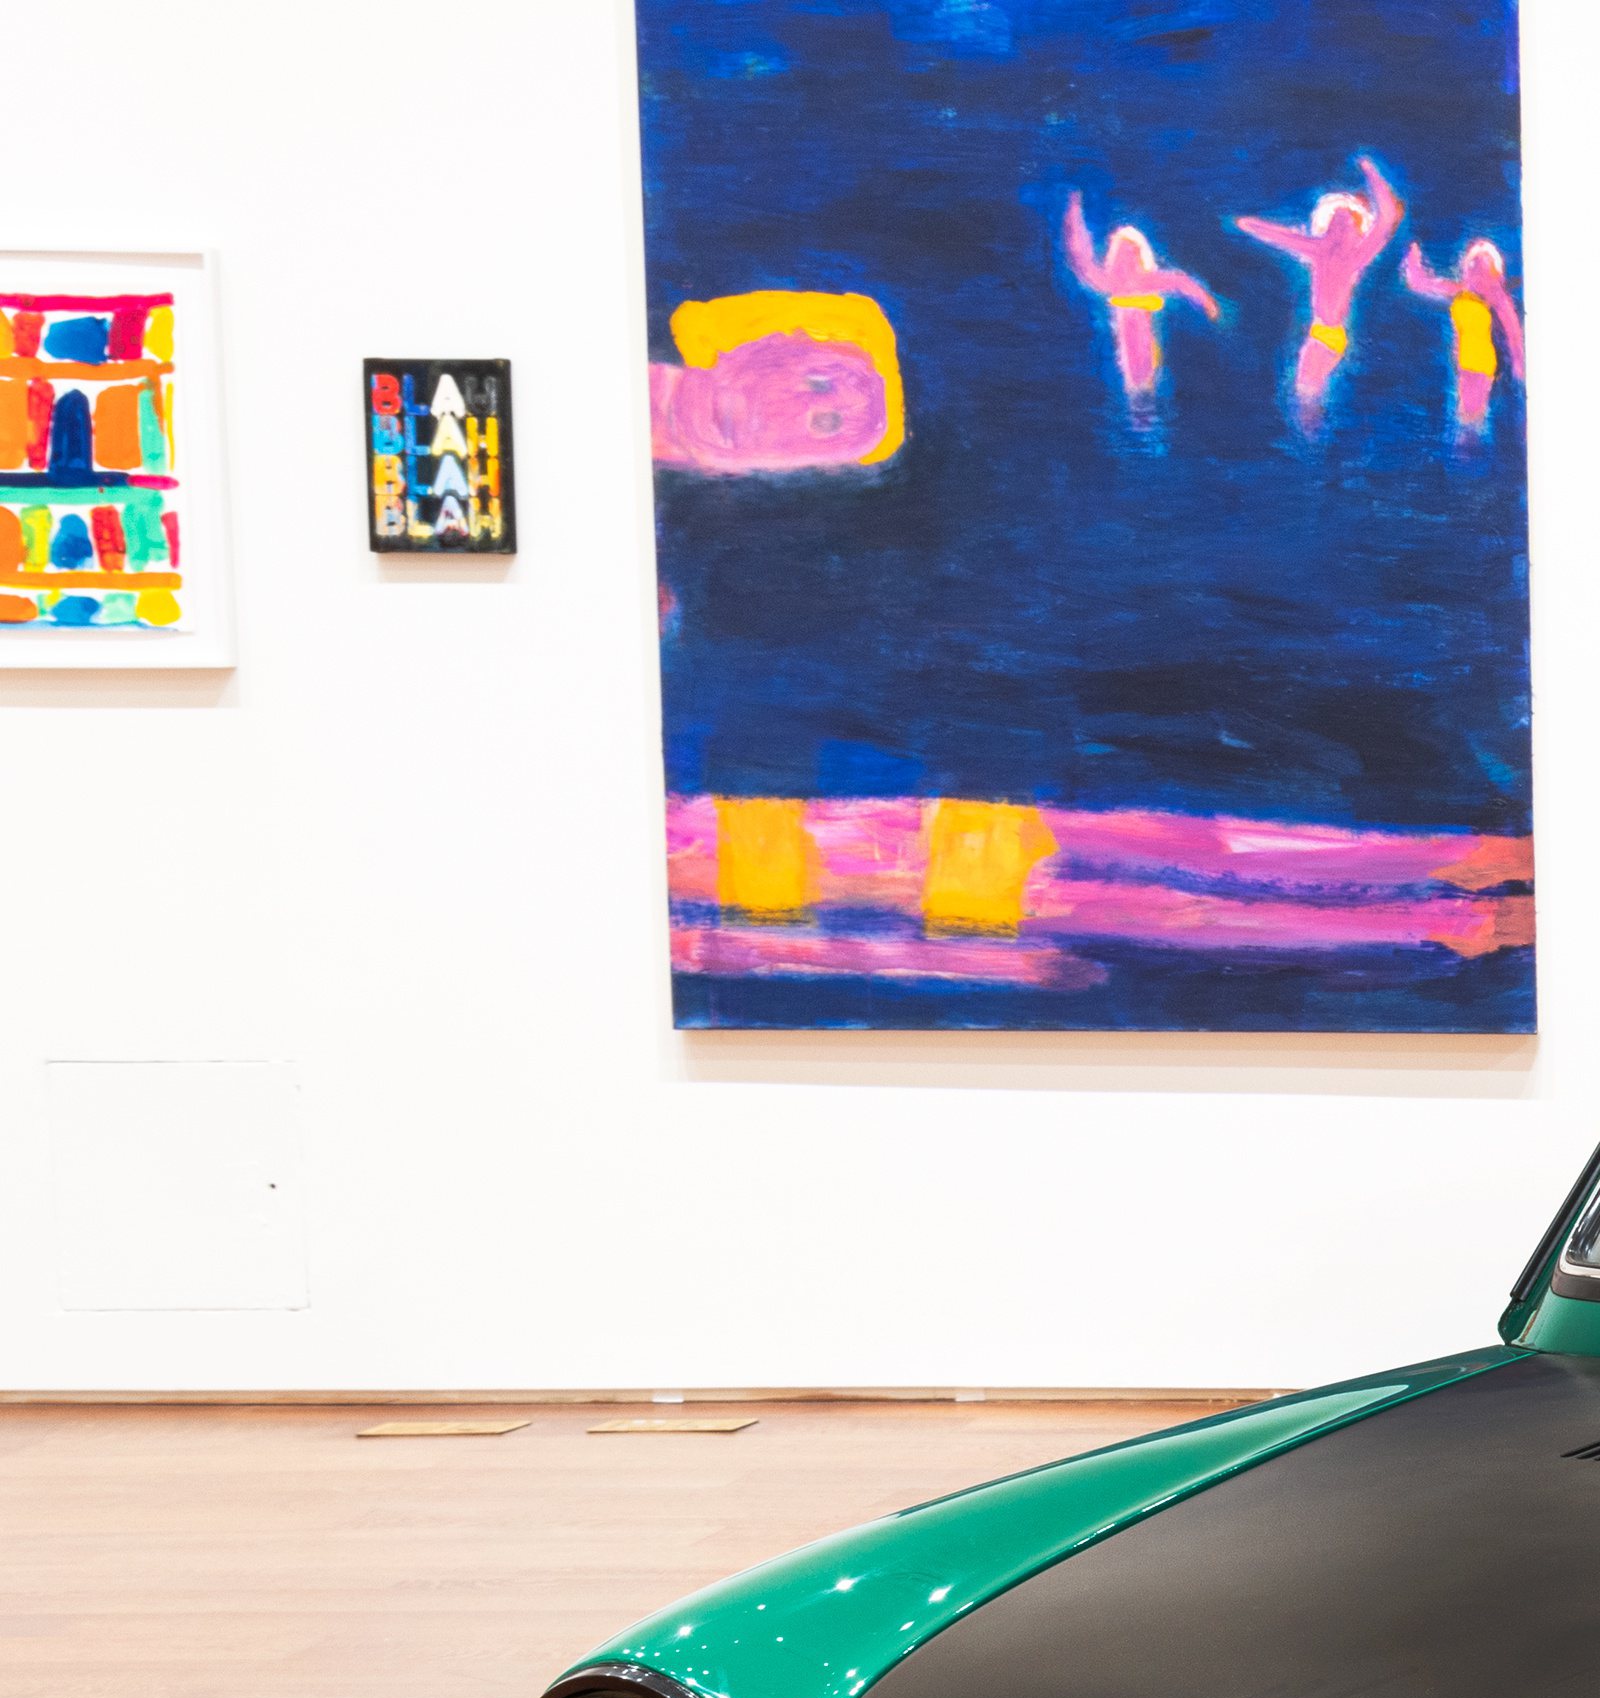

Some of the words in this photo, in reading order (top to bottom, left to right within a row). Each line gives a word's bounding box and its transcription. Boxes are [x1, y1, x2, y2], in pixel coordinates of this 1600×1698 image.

[372, 374, 497, 415] BLAH
[373, 415, 499, 458] BLAH
[374, 454, 501, 497] BLAH
[375, 496, 502, 538] BLAH
